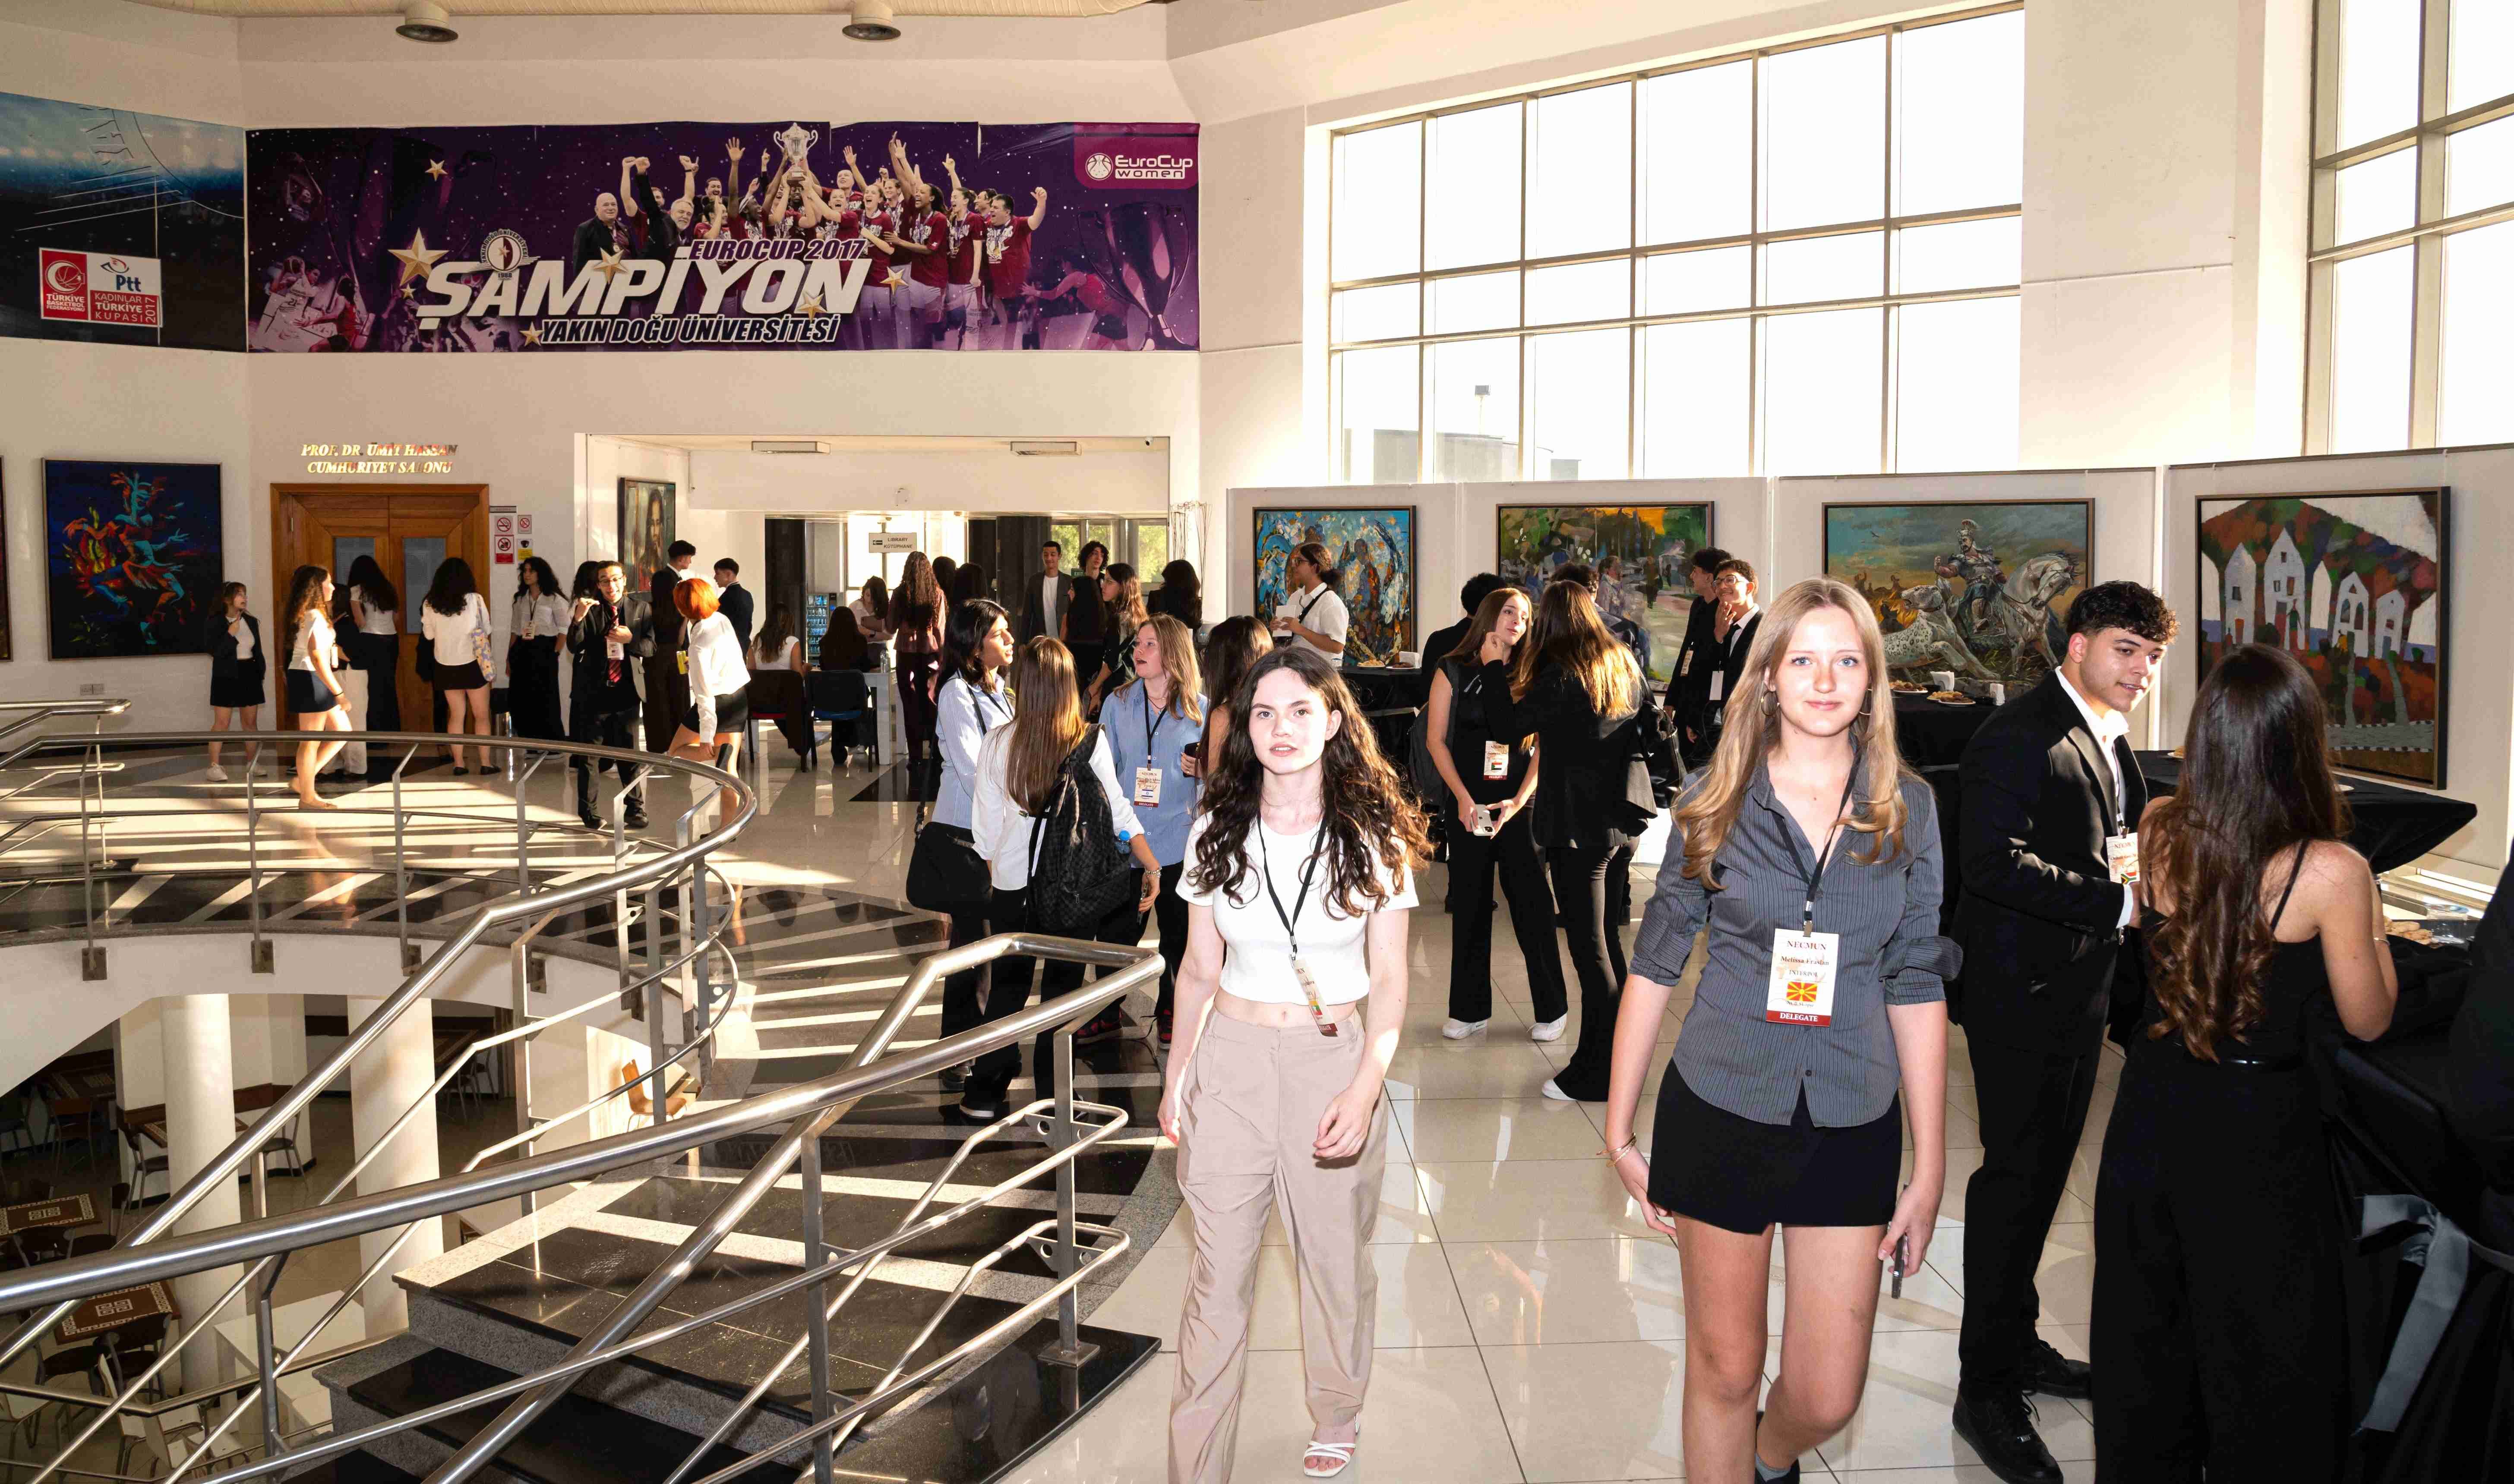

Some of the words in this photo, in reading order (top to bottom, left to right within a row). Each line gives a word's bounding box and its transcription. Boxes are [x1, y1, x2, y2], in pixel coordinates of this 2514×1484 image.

[1115, 155, 1193, 168] EuroCup
[688, 239, 805, 261] EUROCUP
[803, 239, 868, 261] 2017
[116, 274, 141, 292] Ptt
[416, 246, 872, 331] ŞAMPİYON
[47, 293, 85, 302] TÜRKİYE
[95, 293, 142, 303] KADINLAR
[96, 302, 142, 313] TÜRKİYE
[145, 297, 156, 323] 2017
[95, 311, 143, 322] KUPASI
[540, 318, 612, 344] YAKIN
[610, 313, 679, 343] DOĞU
[679, 313, 841, 343] ÜNİVERSİTESİ
[301, 443, 339, 457] PROF.
[341, 444, 363, 457] DR.
[404, 443, 458, 457] HASSAN
[1787, 940, 1827, 950] NECMUN
[1781, 955, 1804, 964] Melissa
[1780, 1013, 1818, 1022] DELEGATE
